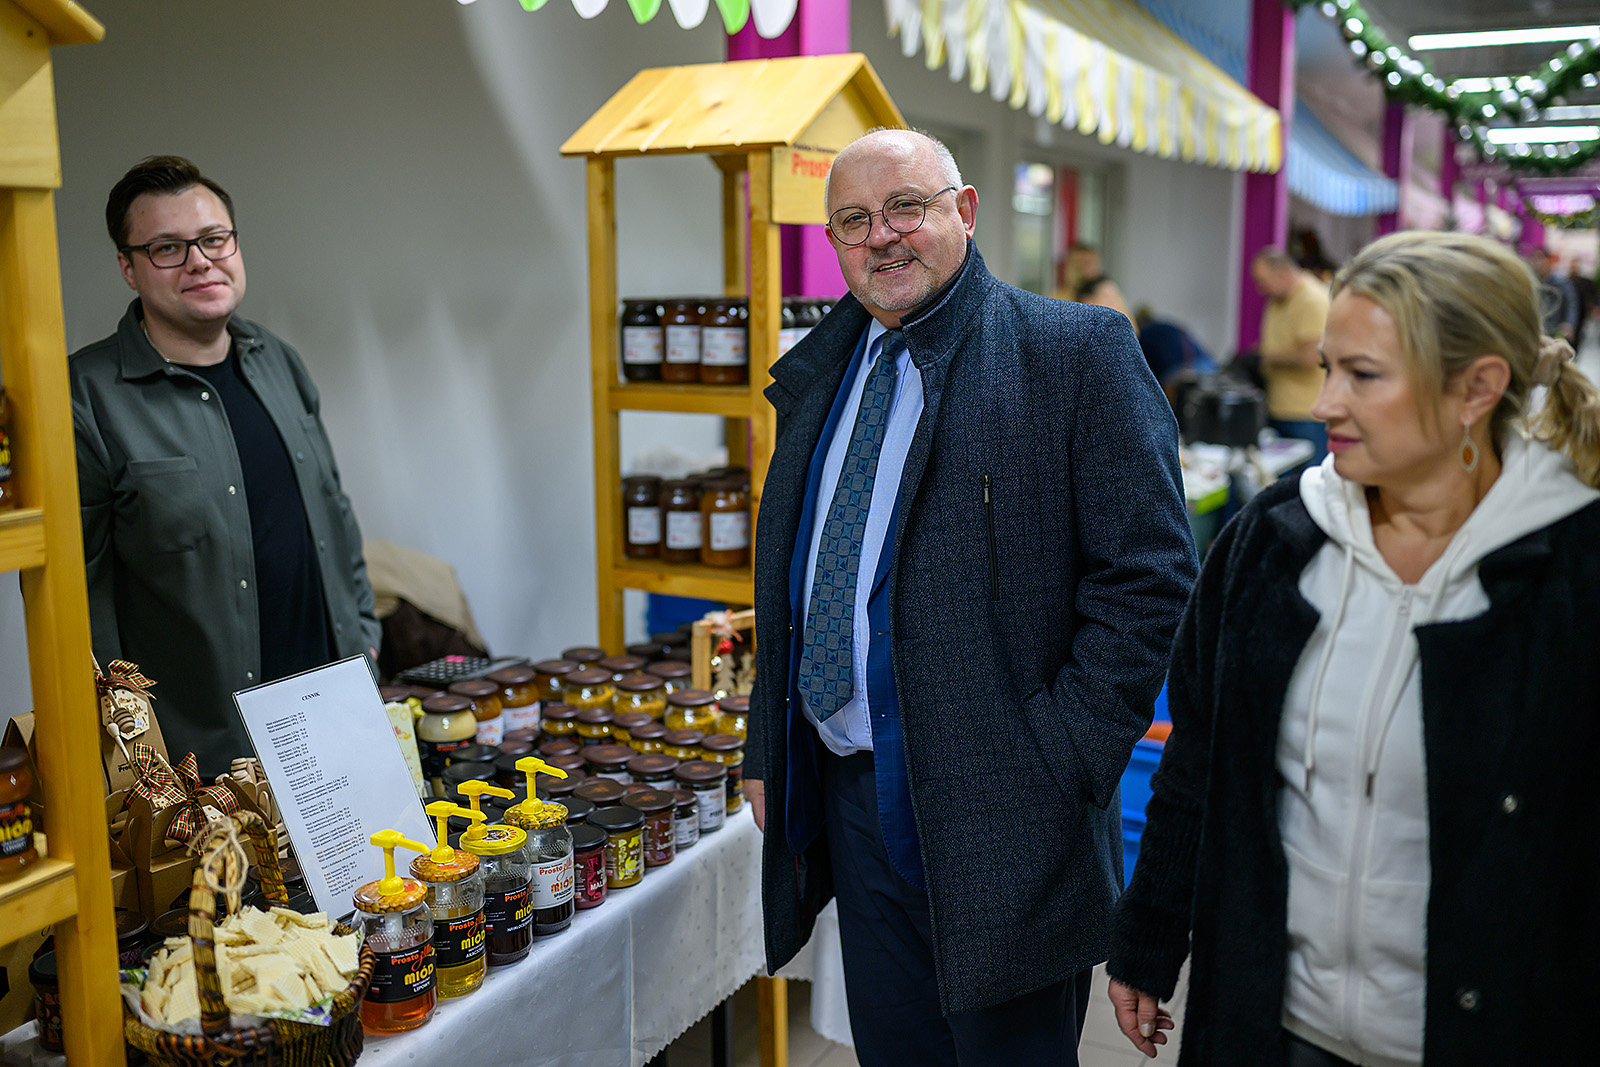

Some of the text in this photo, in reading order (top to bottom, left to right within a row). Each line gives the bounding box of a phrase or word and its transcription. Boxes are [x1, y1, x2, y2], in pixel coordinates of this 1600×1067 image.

[791, 152, 831, 179] Prost
[0, 819, 33, 843] IÓD
[539, 865, 563, 876] Prosto
[551, 876, 573, 893] MIÓD
[504, 890, 526, 902] Prosto
[449, 920, 475, 932] Prosto
[461, 930, 486, 950] MIÓD
[391, 953, 420, 966] Prosto
[404, 963, 434, 986] MIÓD
